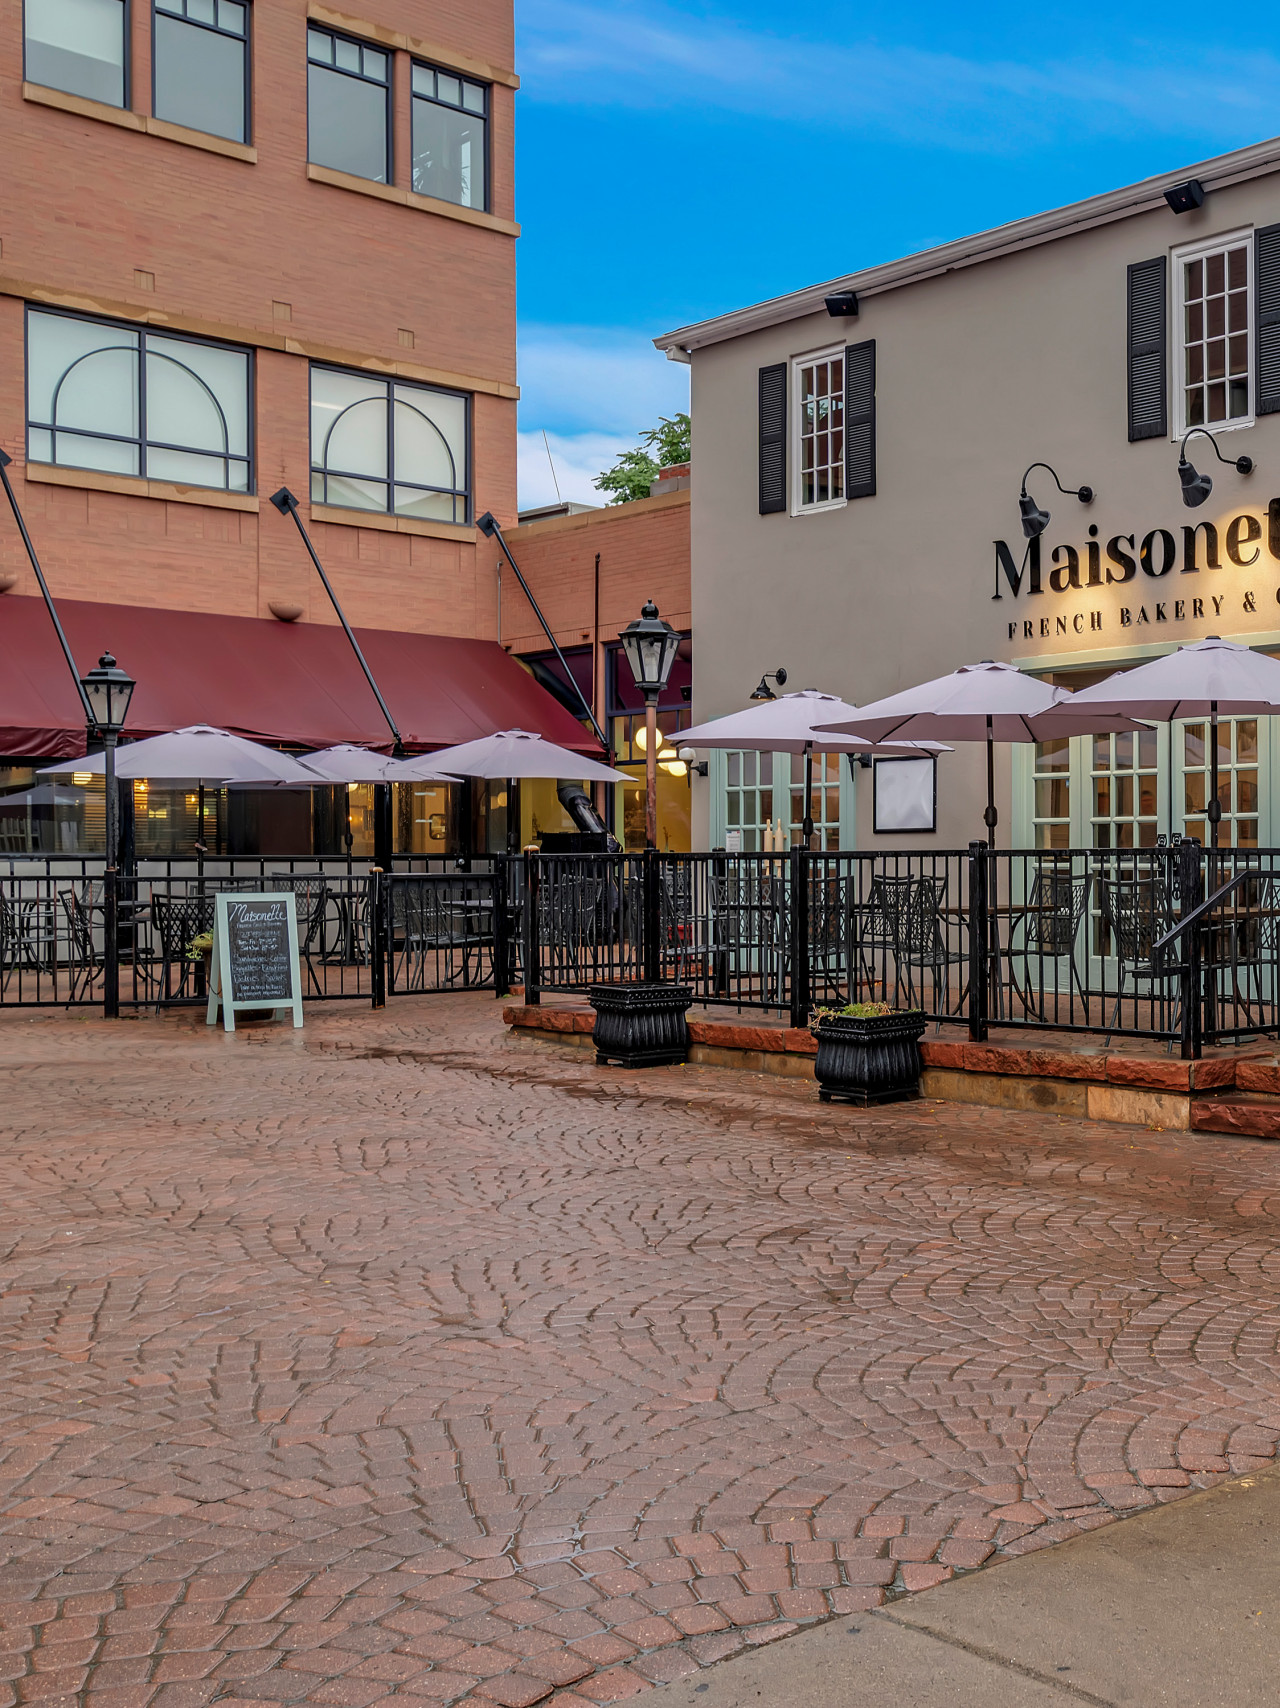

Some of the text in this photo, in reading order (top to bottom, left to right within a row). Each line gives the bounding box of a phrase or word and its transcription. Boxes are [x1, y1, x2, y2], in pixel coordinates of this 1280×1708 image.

[1008, 610, 1104, 640] FRENCH
[1119, 594, 1225, 628] BAKERY
[1242, 590, 1258, 613] &
